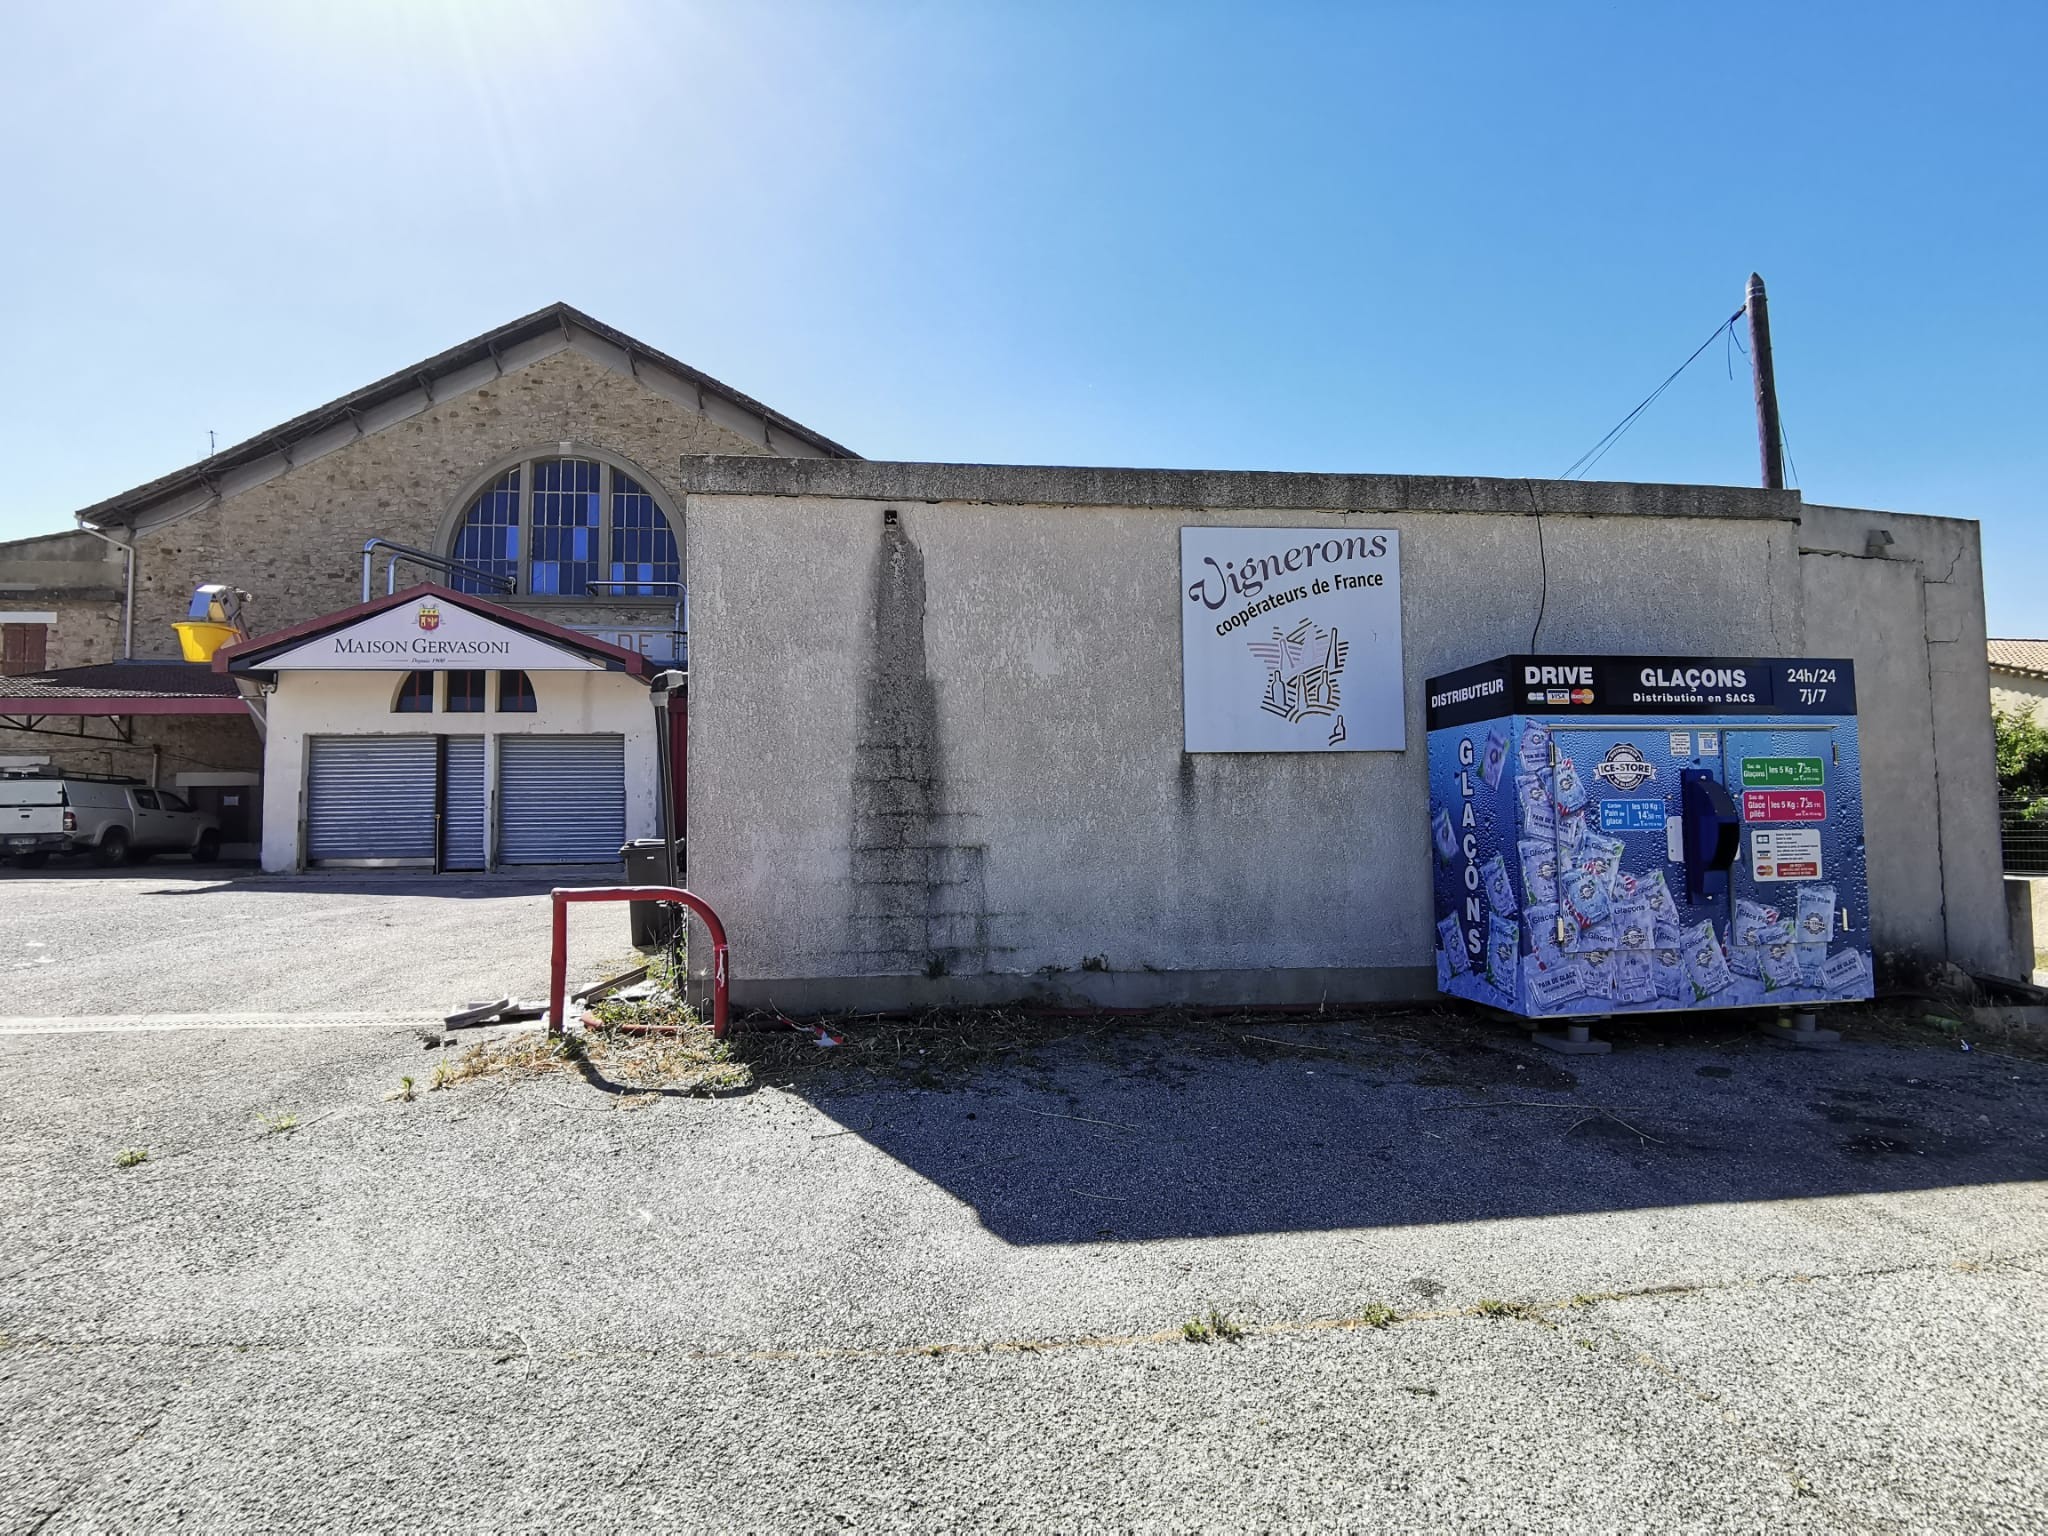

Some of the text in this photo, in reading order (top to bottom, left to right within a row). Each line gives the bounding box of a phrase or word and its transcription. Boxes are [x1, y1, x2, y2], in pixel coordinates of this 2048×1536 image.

[1189, 535, 1387, 609] Vignerons
[1215, 573, 1383, 637] coopérateurs de France
[334, 638, 510, 654] MAISON GERVASONI
[1524, 666, 1594, 685] DRIVE
[1640, 668, 1747, 692] GLAÇONS
[1787, 669, 1836, 683] 24h/24
[1431, 678, 1504, 708] DISTRIBUTEUR
[1633, 693, 1756, 703] Distribution en SACS
[1799, 688, 1827, 705] 7j/7
[1600, 763, 1650, 774] ICE-STORE
[1785, 766, 1793, 775] Kg
[1748, 801, 1766, 809] Glace
[1787, 801, 1796, 810] Kg
[1604, 809, 1618, 817] Pain
[1606, 818, 1623, 826] glace
[1459, 738, 1482, 954] GLAÇONS
